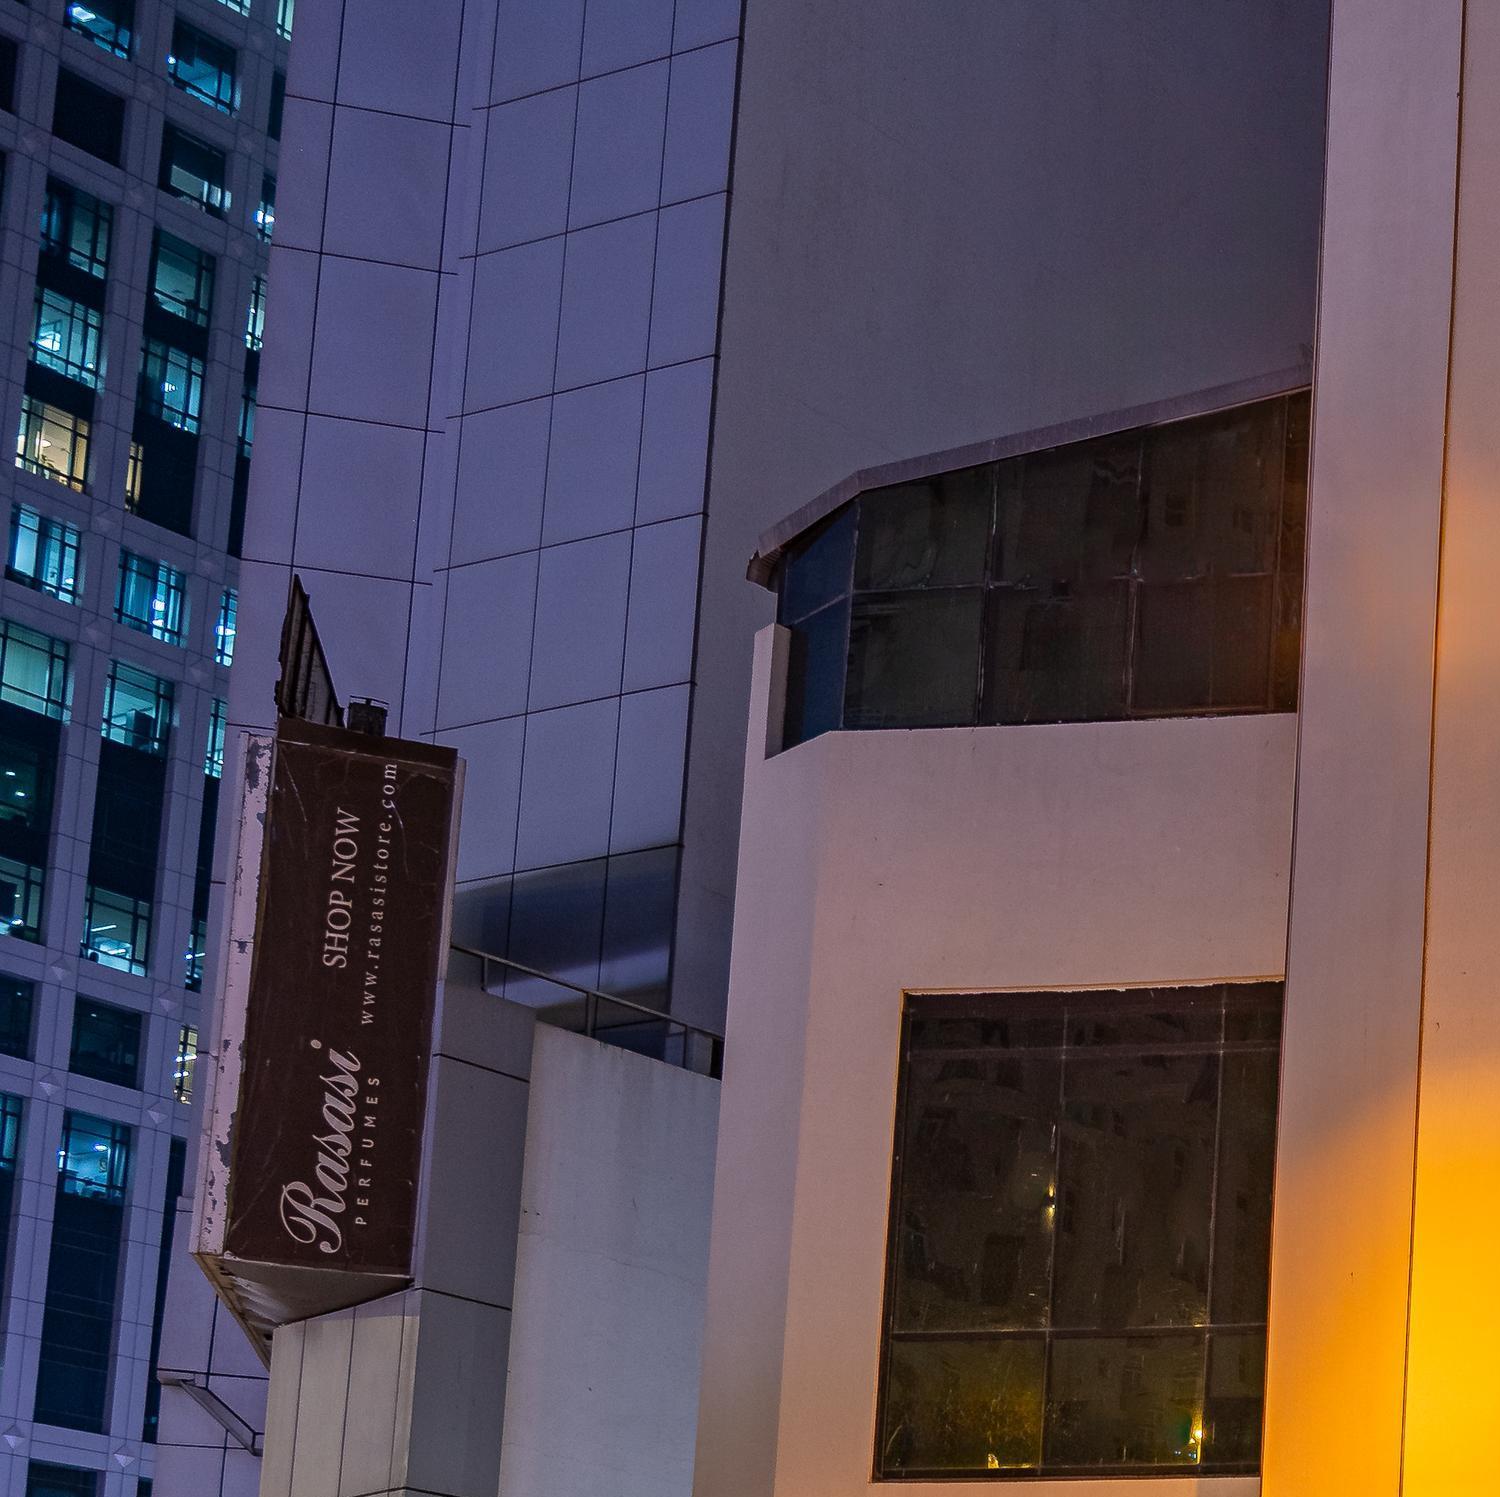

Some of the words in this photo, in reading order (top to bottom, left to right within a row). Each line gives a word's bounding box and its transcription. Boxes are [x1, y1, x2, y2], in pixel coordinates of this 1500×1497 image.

[331, 806, 362, 884] NOW
[360, 762, 398, 1026] www.rasasistore.com
[322, 889, 353, 970] SHOP
[280, 1039, 361, 1254] Rasasi
[354, 1077, 381, 1226] PERFUMES
